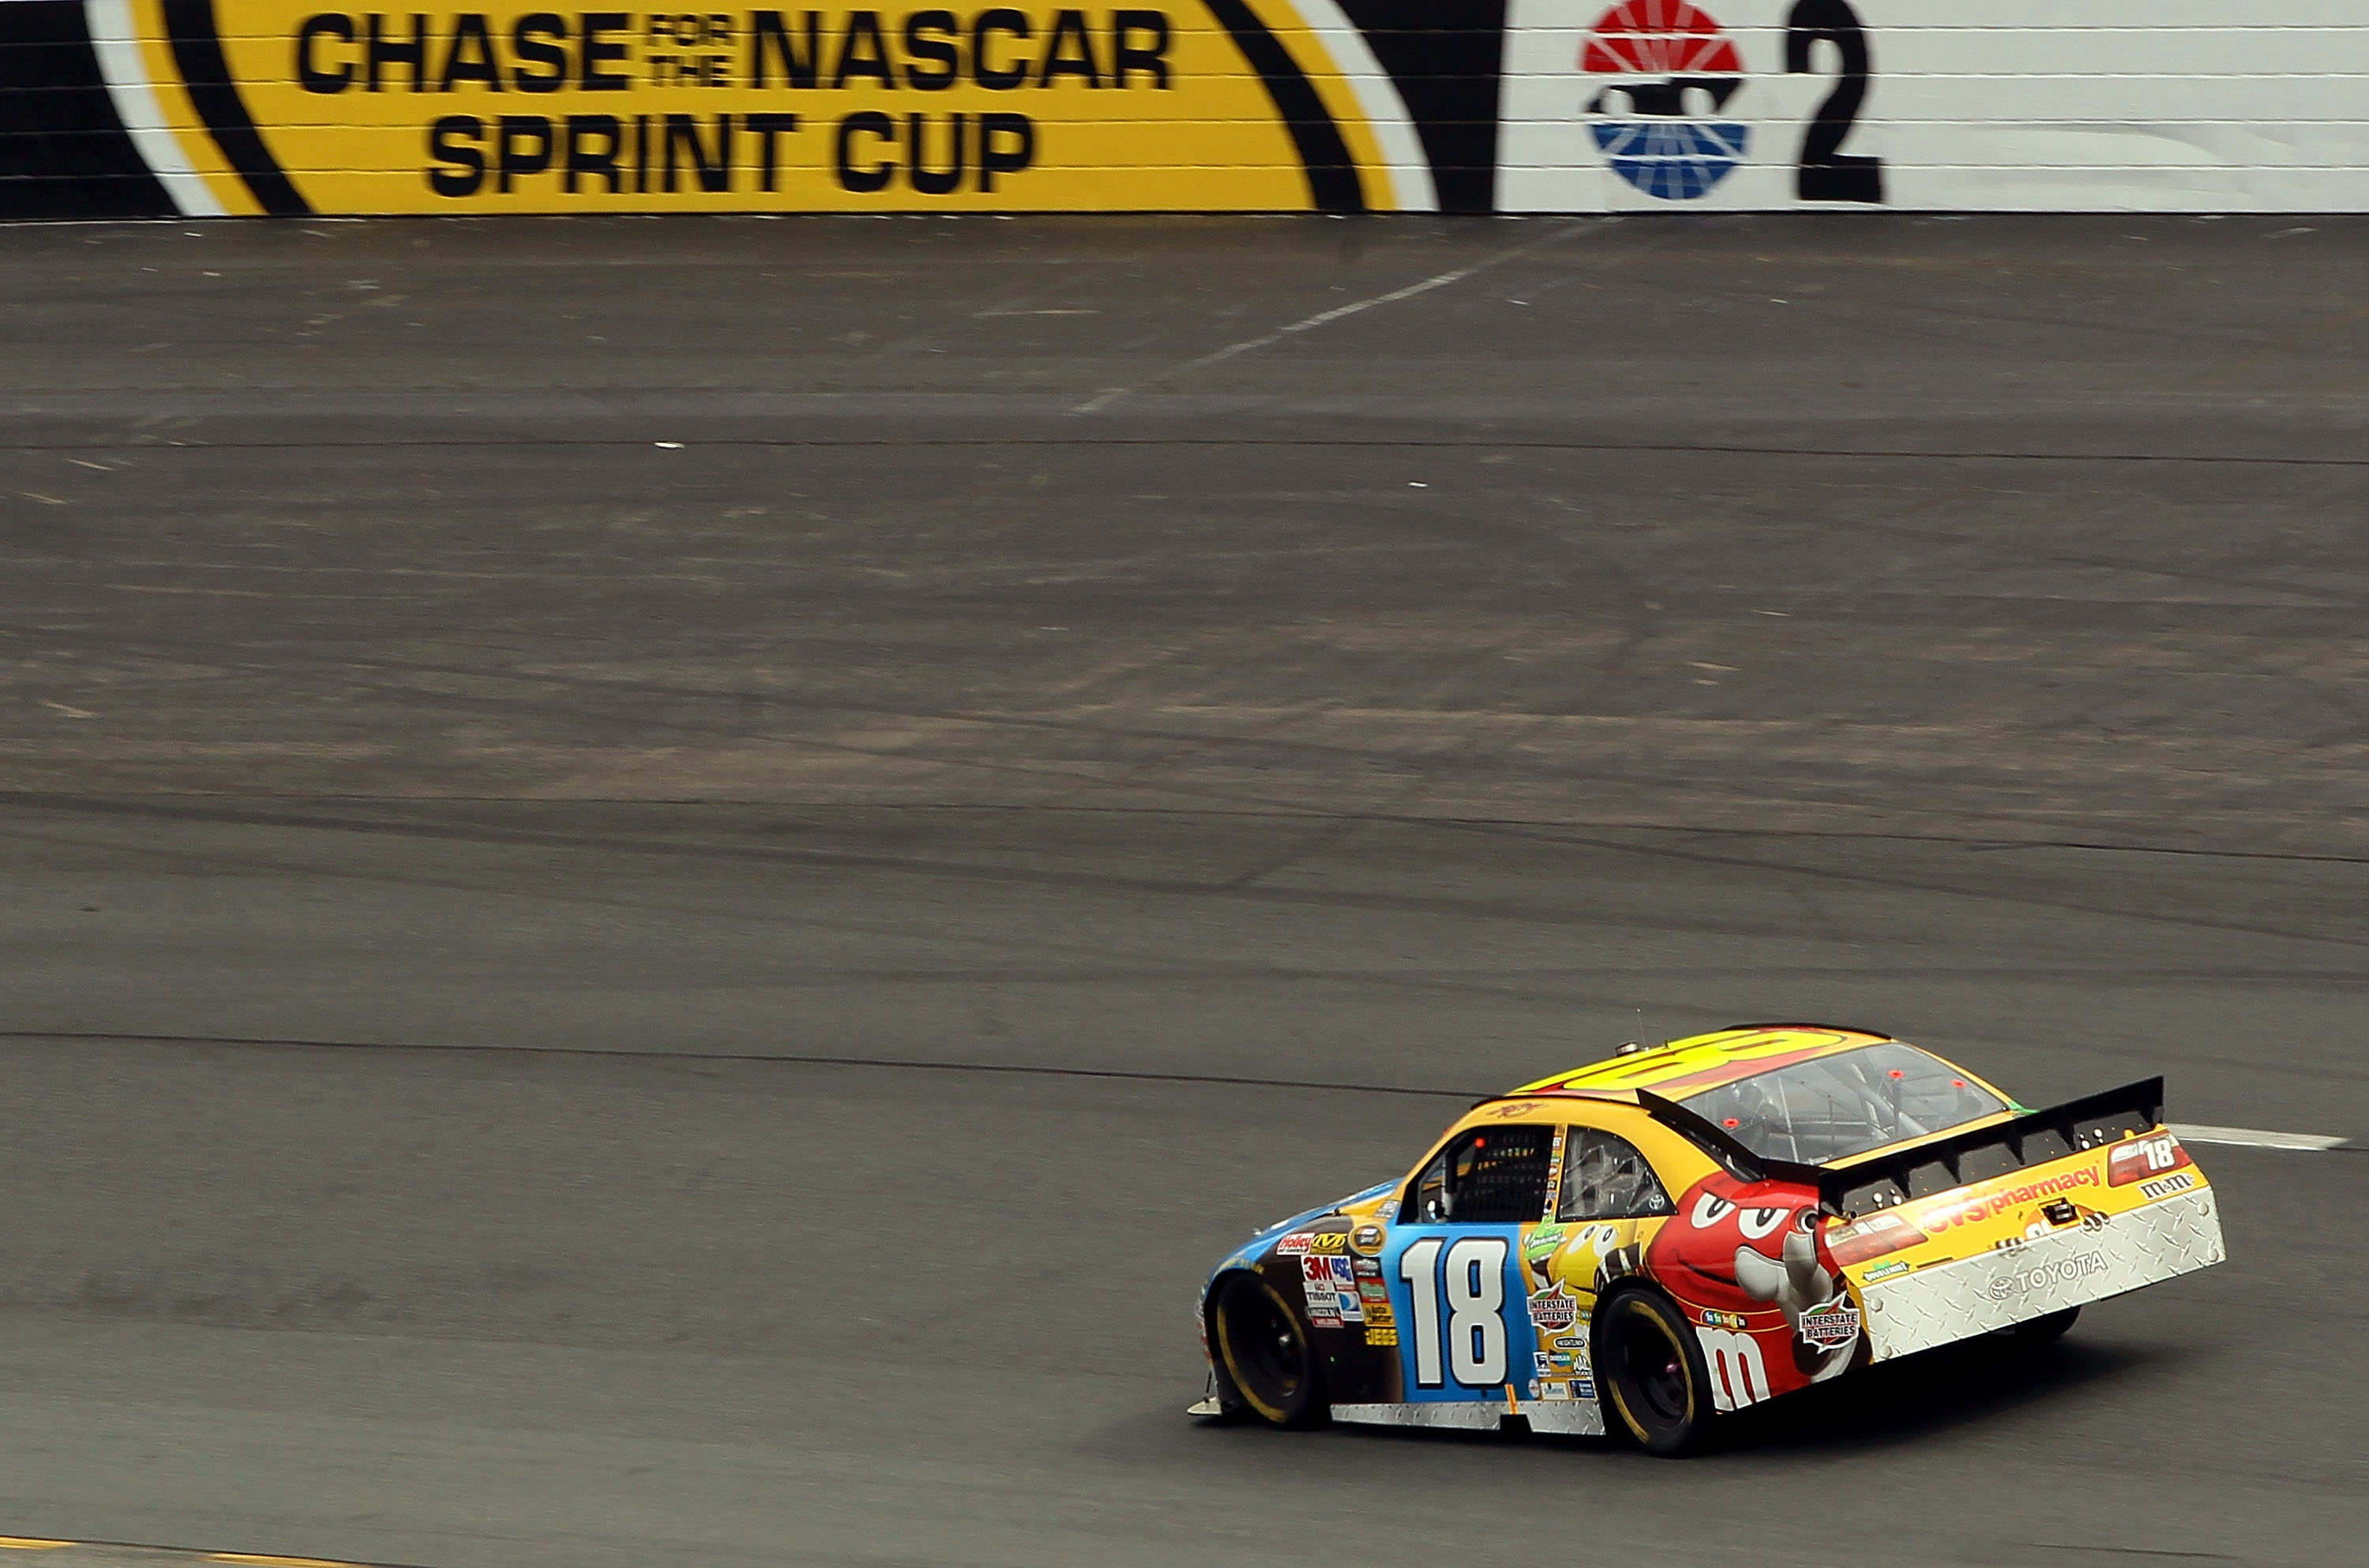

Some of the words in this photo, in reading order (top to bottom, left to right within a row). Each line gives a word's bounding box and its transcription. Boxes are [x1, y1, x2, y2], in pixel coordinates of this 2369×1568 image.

[646, 13, 735, 46] FOR
[295, 12, 632, 94] CHASE
[746, 8, 1175, 90] NASCAR
[644, 55, 733, 87] THE
[1784, 0, 1886, 204] 2
[423, 111, 802, 198] SPRINT
[835, 110, 1039, 195] CUP
[2138, 1139, 2176, 1170] 18
[1279, 1234, 1312, 1251] Holley
[1304, 1257, 1332, 1281] 3M
[1331, 1257, 1353, 1281] USG
[2016, 1251, 2108, 1293] TOYOTA
[1306, 1292, 1337, 1301] TISSOT
[1399, 1238, 1507, 1386] 18
[1529, 1300, 1575, 1311] INTERSTATE
[1533, 1311, 1574, 1322] BATTERIES
[1803, 1313, 1857, 1327] INTERSTATE
[1807, 1325, 1856, 1339] BATTERIES
